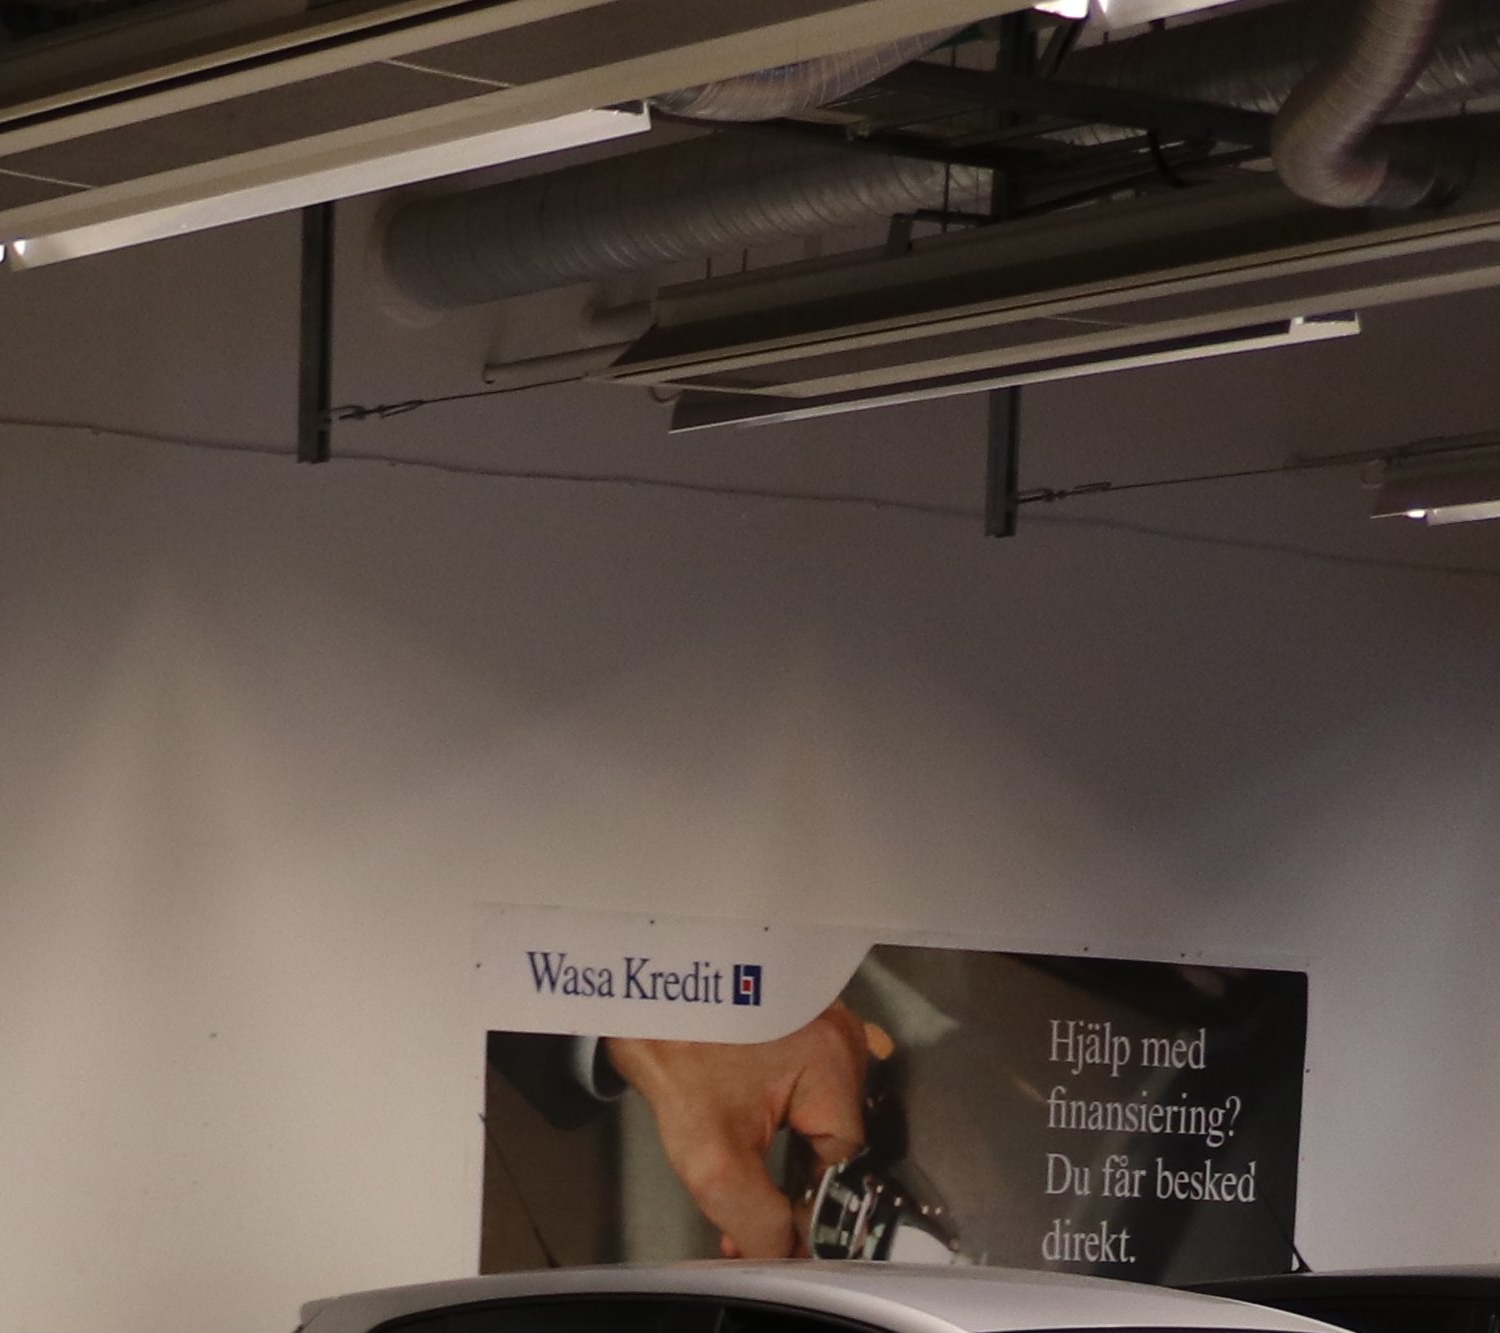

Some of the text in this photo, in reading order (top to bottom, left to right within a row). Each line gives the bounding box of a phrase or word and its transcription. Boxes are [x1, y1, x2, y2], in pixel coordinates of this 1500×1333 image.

[526, 951, 724, 1004] Wasa Kredit
[1049, 1019, 1207, 1077] Hjälp med
[1047, 1085, 1242, 1147] finansiering?
[1044, 1152, 1257, 1202] Du får besked
[1042, 1218, 1136, 1264] direkt.
